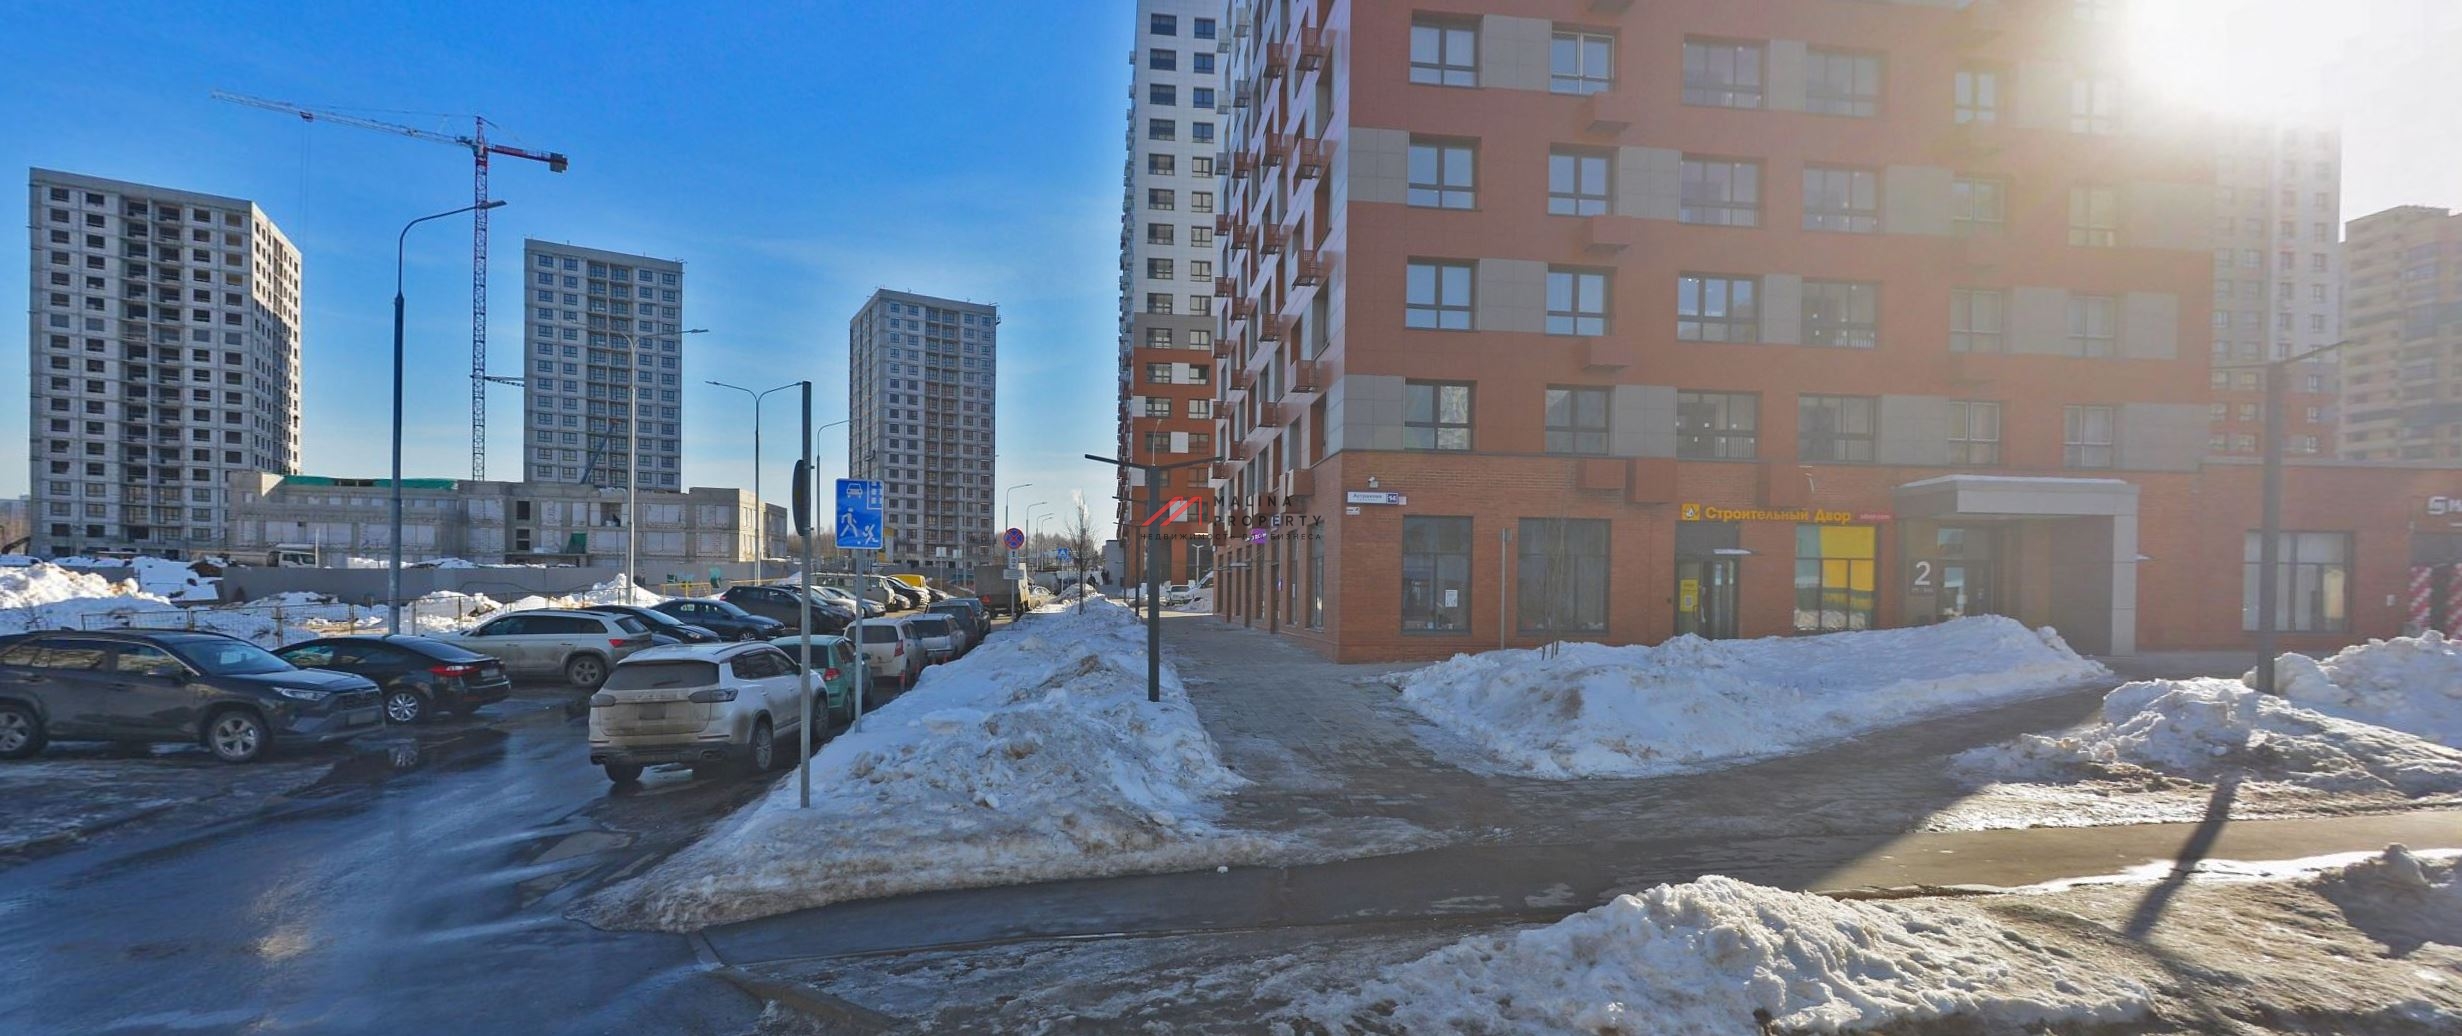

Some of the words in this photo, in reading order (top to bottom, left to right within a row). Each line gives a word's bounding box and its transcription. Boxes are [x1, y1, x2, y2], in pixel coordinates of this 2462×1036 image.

[1704, 506, 1808, 522] Строительный
[1814, 508, 1851, 525] Двор
[1914, 560, 1931, 586] 2
